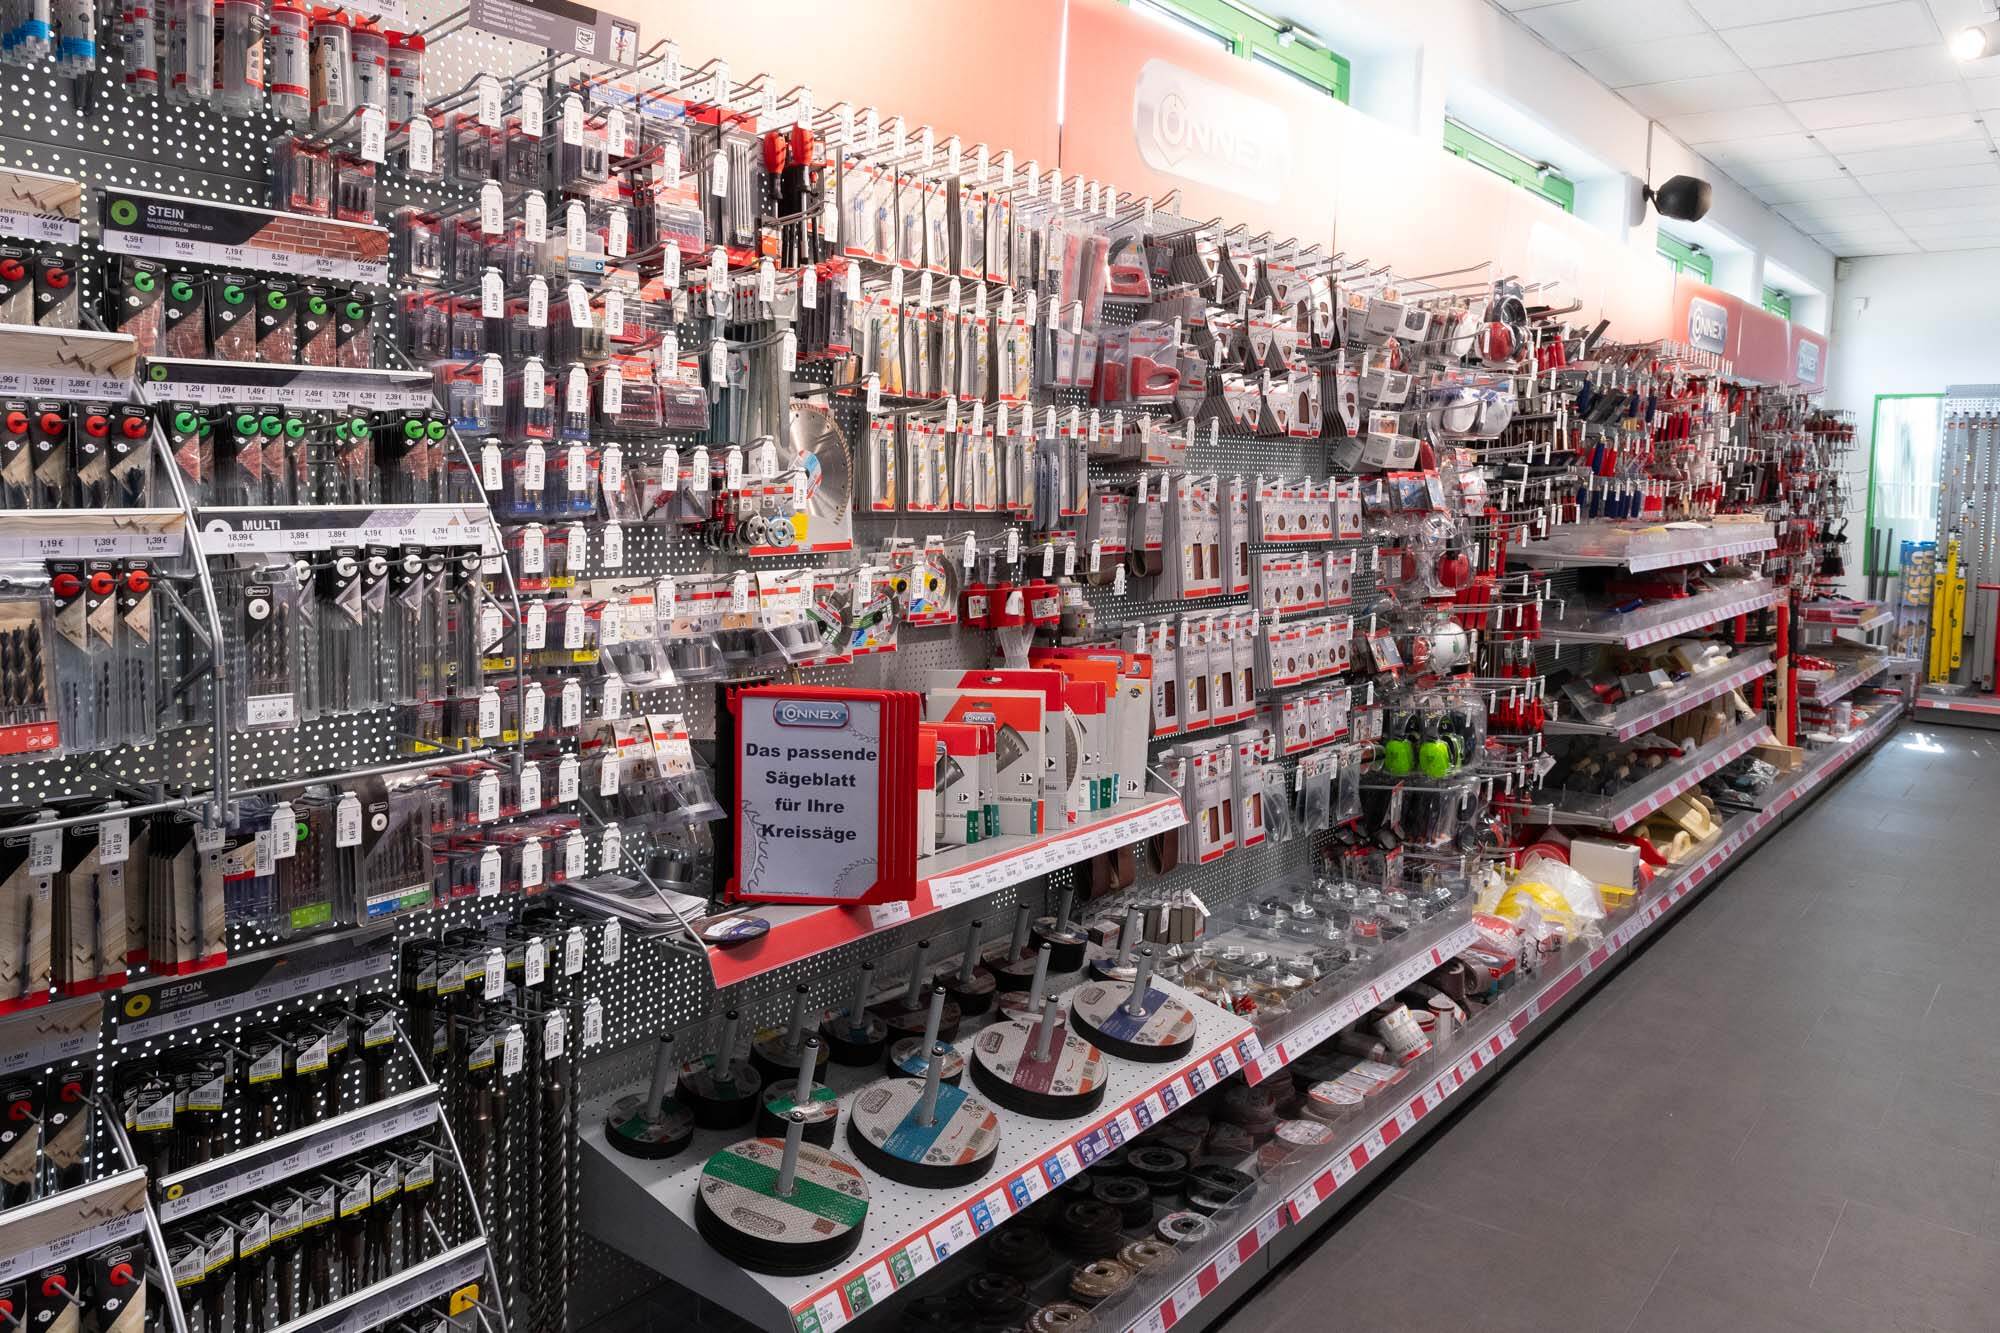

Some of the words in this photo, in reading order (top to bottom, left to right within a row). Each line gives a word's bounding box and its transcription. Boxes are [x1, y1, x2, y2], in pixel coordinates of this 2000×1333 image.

[148, 205, 184, 220] STEIN
[42, 221, 58, 230] 9,49
[124, 234, 139, 244] 4,59
[176, 241, 190, 250] 5,69
[225, 248, 239, 256] 7,19
[358, 264, 372, 272] 12,99
[33, 377, 50, 386] 3,69
[242, 520, 280, 530] MULTI
[94, 538, 111, 547] 1,39
[112, 538, 118, 546] €
[146, 537, 162, 546] 1,39
[162, 536, 168, 544] €
[228, 534, 248, 542] 18,99
[40, 540, 56, 548] 1,19
[746, 743, 780, 758] Das
[787, 748, 877, 762] passende
[766, 771, 856, 788] Sägeblatt
[775, 798, 801, 812] für
[808, 799, 844, 814] Ihre
[762, 824, 856, 844] Kreissäge
[161, 981, 202, 998] BETON
[50, 1238, 70, 1252] 16,99
